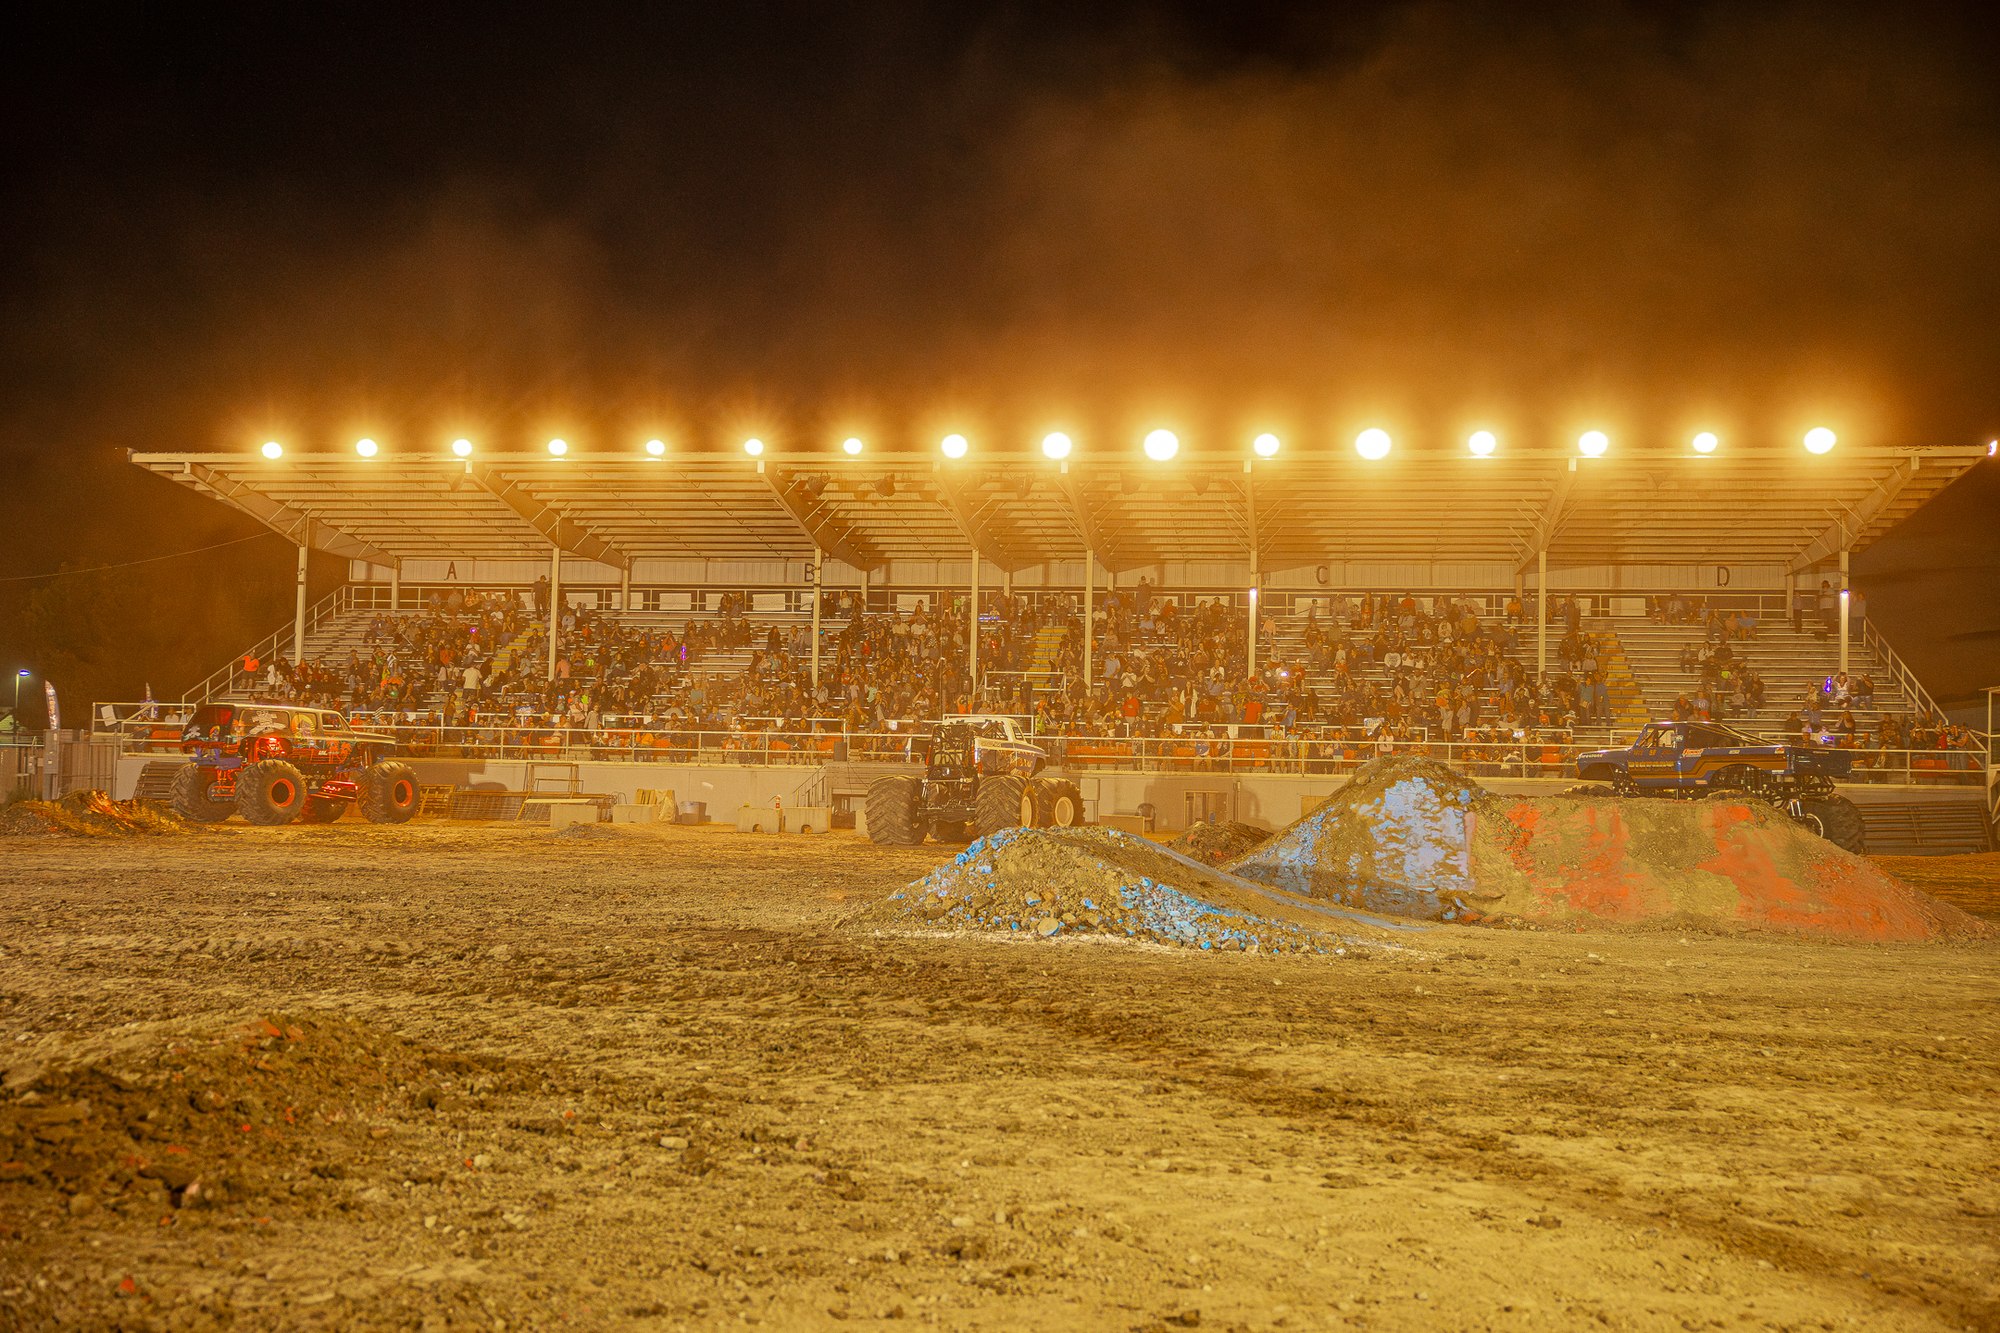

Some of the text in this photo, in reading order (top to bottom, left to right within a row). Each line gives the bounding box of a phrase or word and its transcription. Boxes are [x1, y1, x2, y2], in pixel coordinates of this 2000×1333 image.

[446, 561, 457, 580] A
[804, 562, 815, 582] B
[1316, 565, 1328, 585] C
[1717, 566, 1730, 587] D
